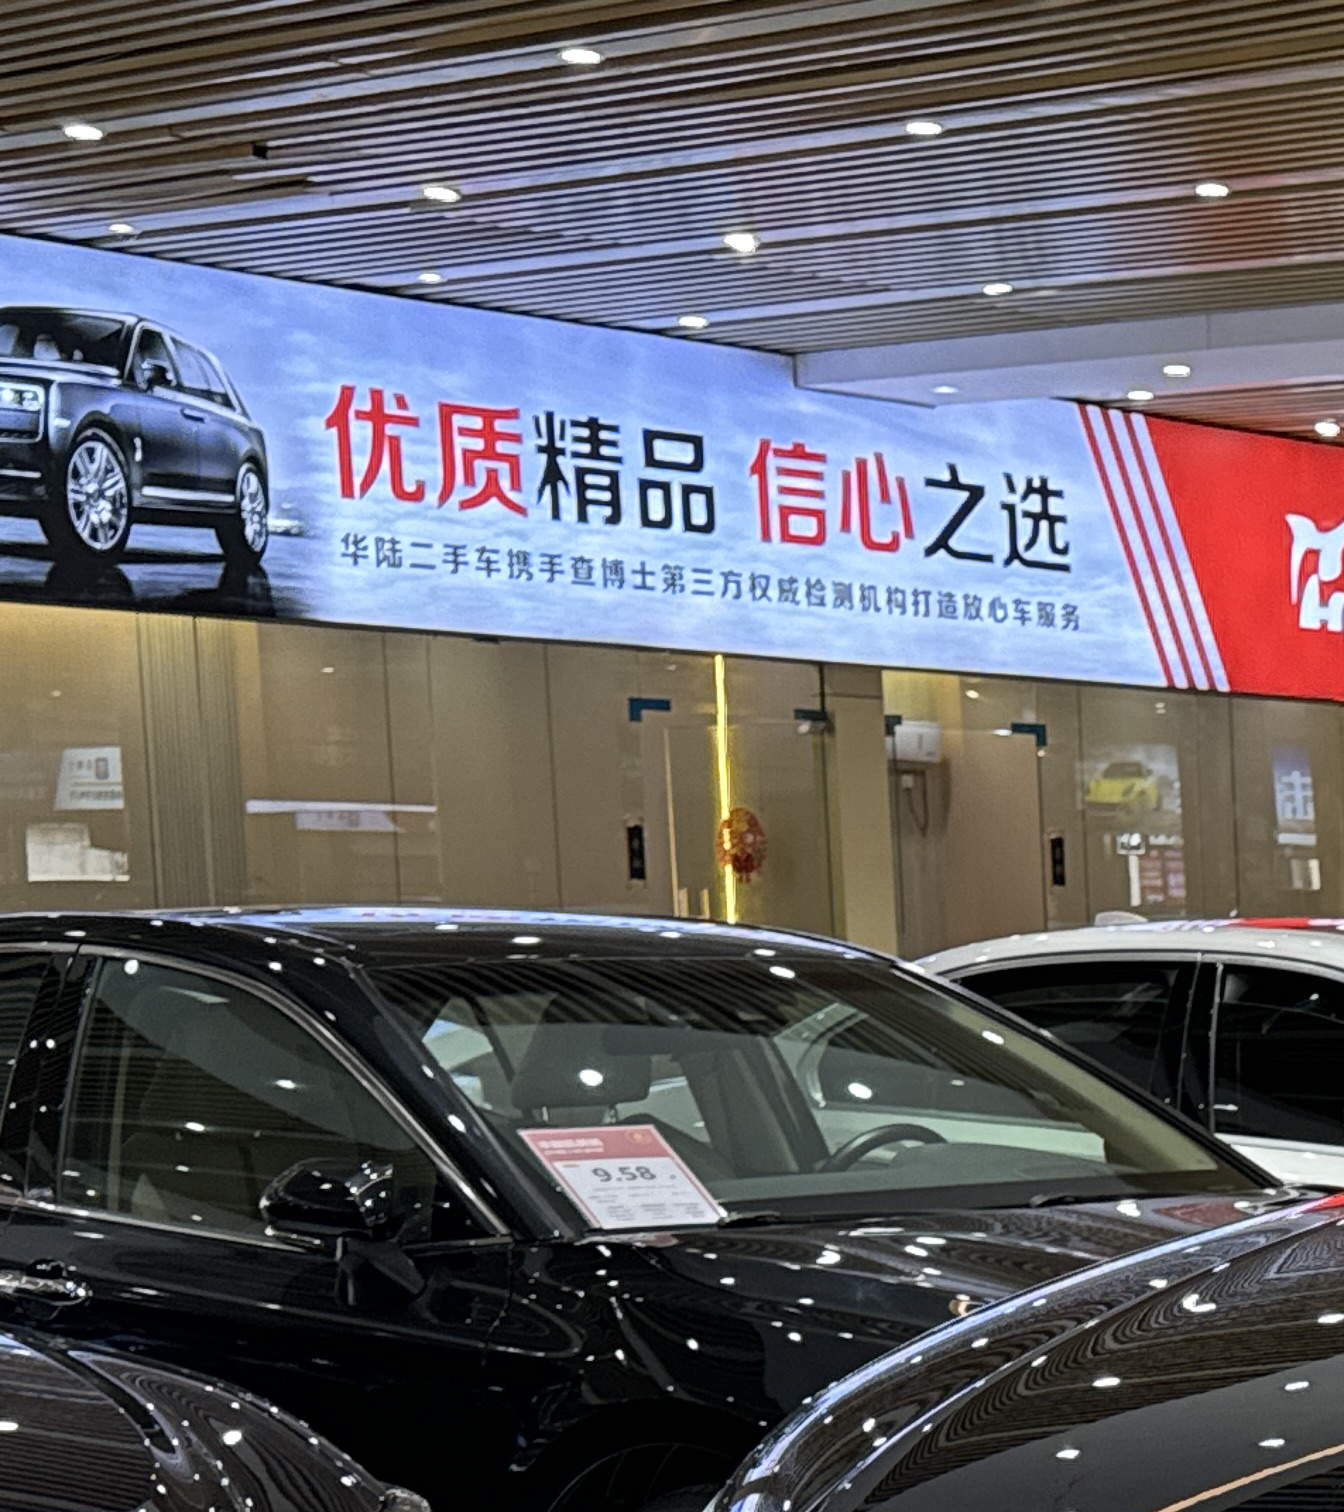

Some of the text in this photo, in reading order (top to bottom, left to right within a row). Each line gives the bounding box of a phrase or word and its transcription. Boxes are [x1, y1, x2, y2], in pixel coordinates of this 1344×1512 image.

[325, 384, 1073, 573] 优质精品 信心之选
[591, 1165, 657, 1183] 9.58
